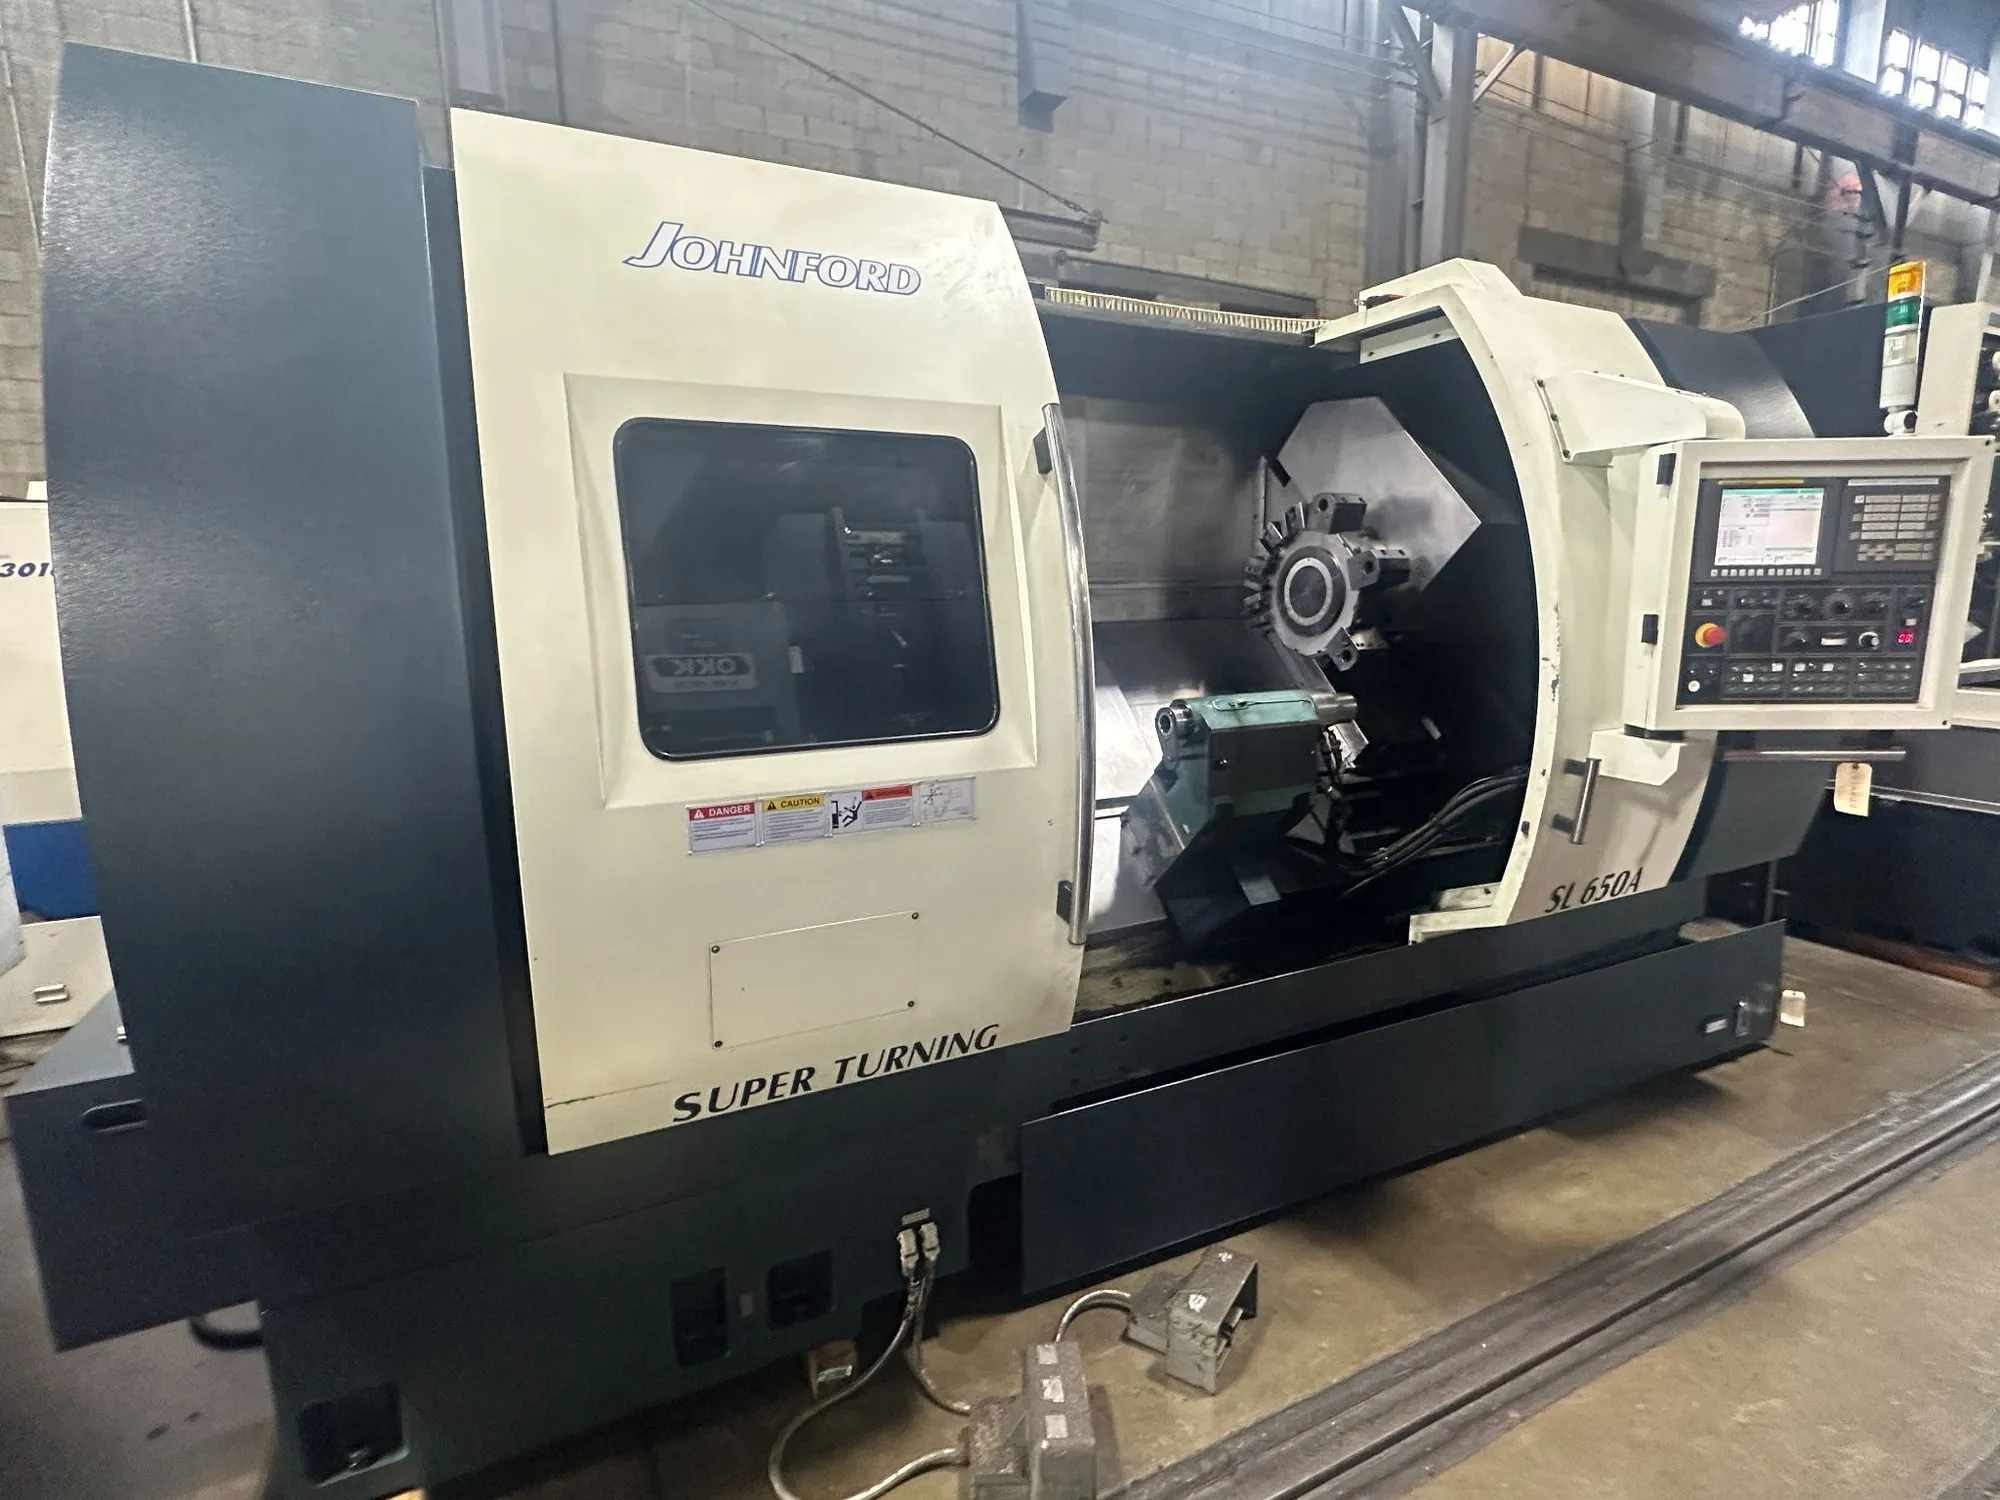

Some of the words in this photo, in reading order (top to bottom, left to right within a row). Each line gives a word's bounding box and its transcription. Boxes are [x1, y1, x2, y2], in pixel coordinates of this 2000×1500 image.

[622, 221, 921, 296] JOHNFORD
[708, 804, 751, 817] DANGER
[780, 796, 820, 809] CAUTION
[1545, 882, 1576, 913] SL
[1580, 866, 1643, 905] 650A
[672, 1066, 816, 1122] SUPER
[834, 1023, 1000, 1084] TURNING
